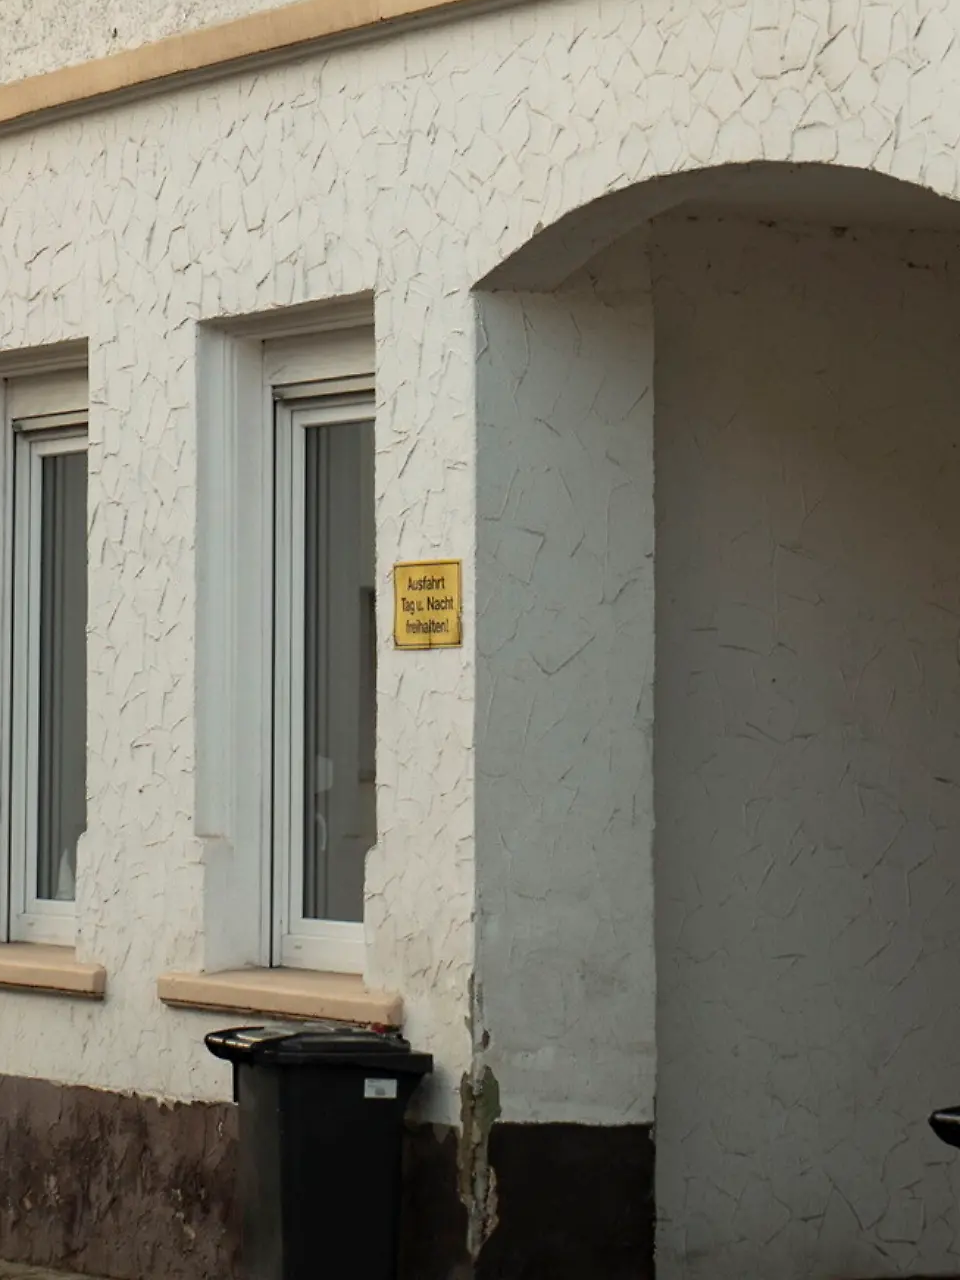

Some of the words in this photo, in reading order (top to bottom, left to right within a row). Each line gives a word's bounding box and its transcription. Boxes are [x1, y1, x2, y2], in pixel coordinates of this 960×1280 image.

[407, 576, 445, 591] Ausfahrt
[401, 597, 415, 616] Tag
[427, 596, 454, 611] Nacht
[405, 619, 449, 634] freihalten!
